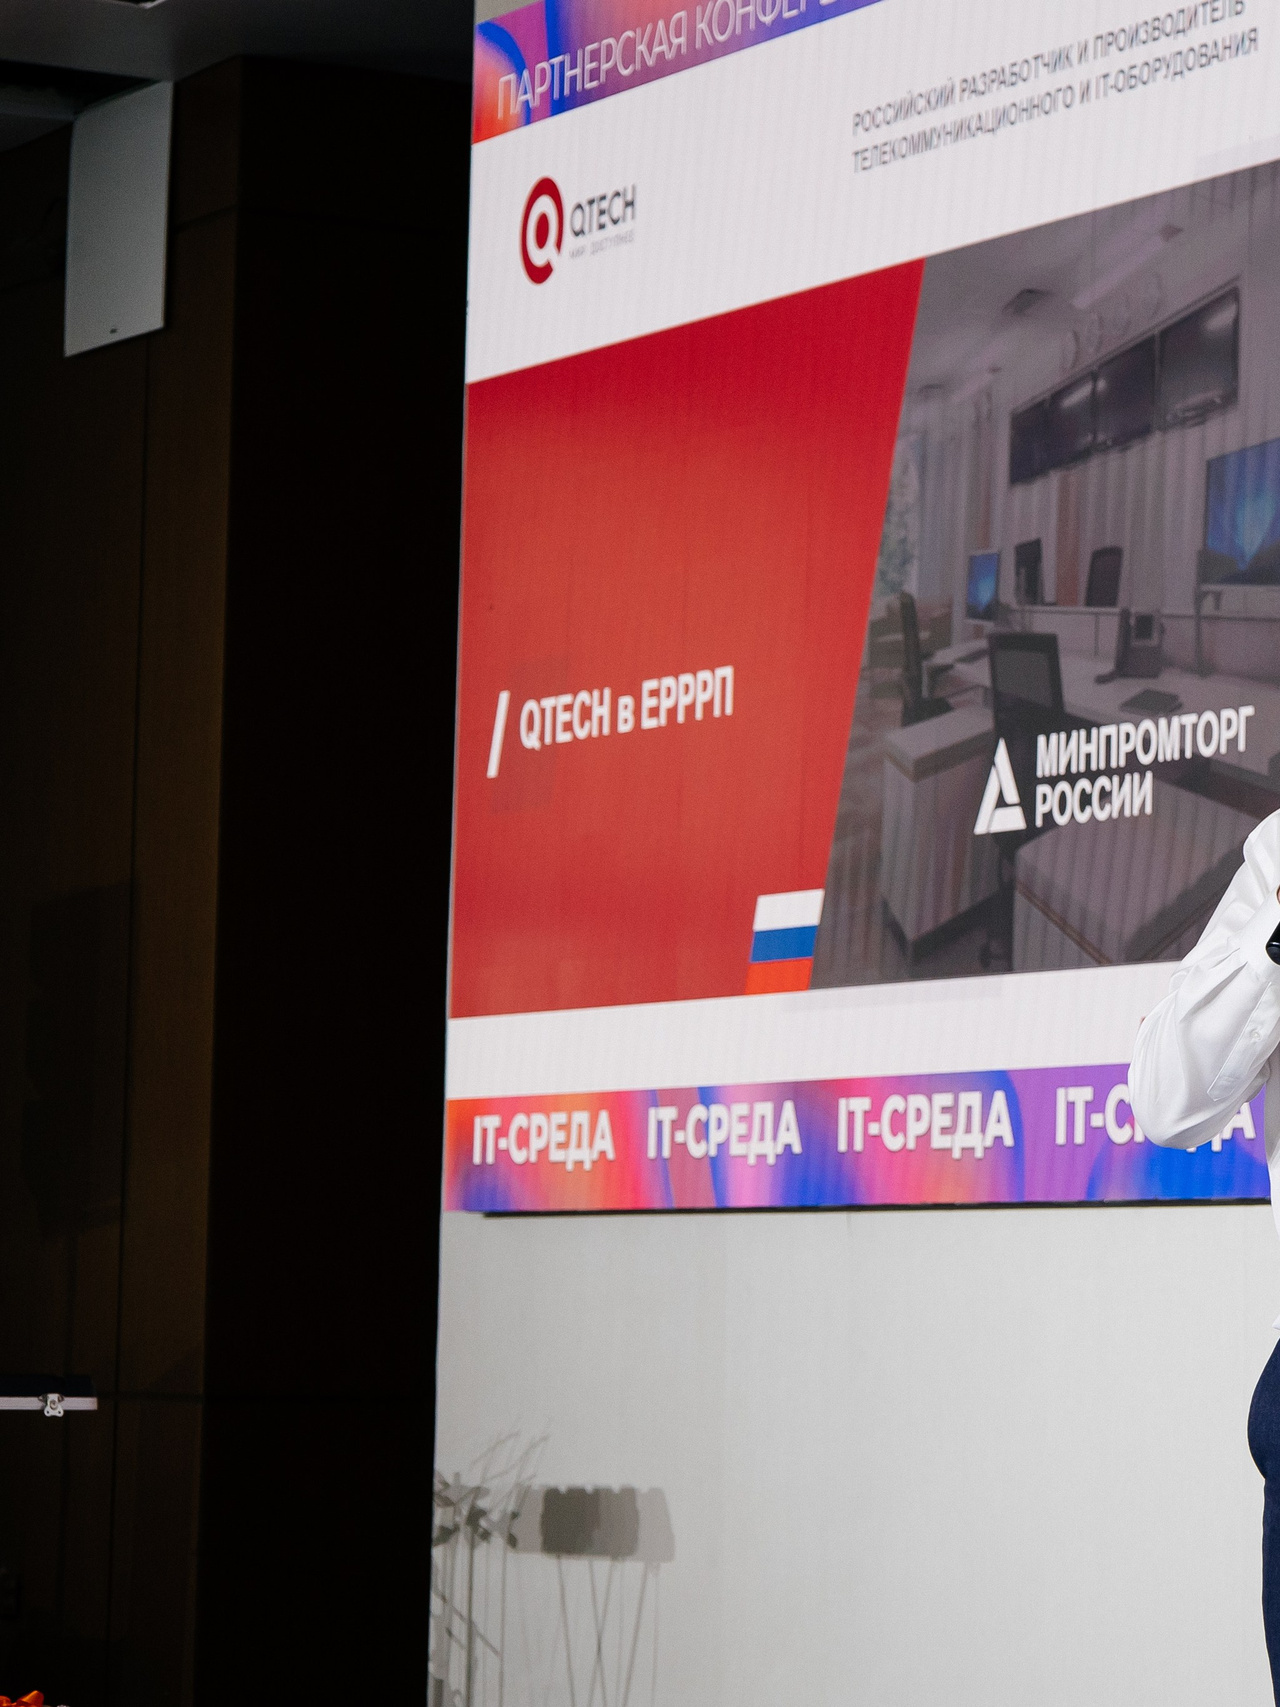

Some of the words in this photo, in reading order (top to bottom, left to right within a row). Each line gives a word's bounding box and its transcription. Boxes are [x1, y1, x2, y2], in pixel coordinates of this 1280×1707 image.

[497, 10, 688, 119] ПАРТНЕРСКАЯ
[696, 0, 837, 49] КОНФ
[852, 76, 955, 136] РОССИЙСКИЙ
[959, 49, 1074, 103] РАЗРАБОТЧИК
[1077, 43, 1090, 66] И
[1093, 0, 1245, 61] ПРОИЗВОДИТЕЛЬ
[852, 85, 1075, 174] ТЕЛЕКОММУНИКАЦИОННОГО
[1080, 78, 1092, 102] И
[1095, 27, 1259, 98] IT-ОБОРУДОВАНИЯ
[569, 184, 637, 238] QTECH
[519, 686, 612, 750] QTECH
[640, 665, 735, 730] ЕРРРП
[1036, 705, 1256, 779] МИНПРОМТОРГ
[1035, 770, 1153, 828] РОССИИ
[472, 1109, 616, 1172] IT-СРЕДА
[647, 1100, 802, 1166] IT-СРЕДА
[837, 1089, 1015, 1160] IT-СРЕДА
[1055, 1083, 1257, 1153] IT-СА
